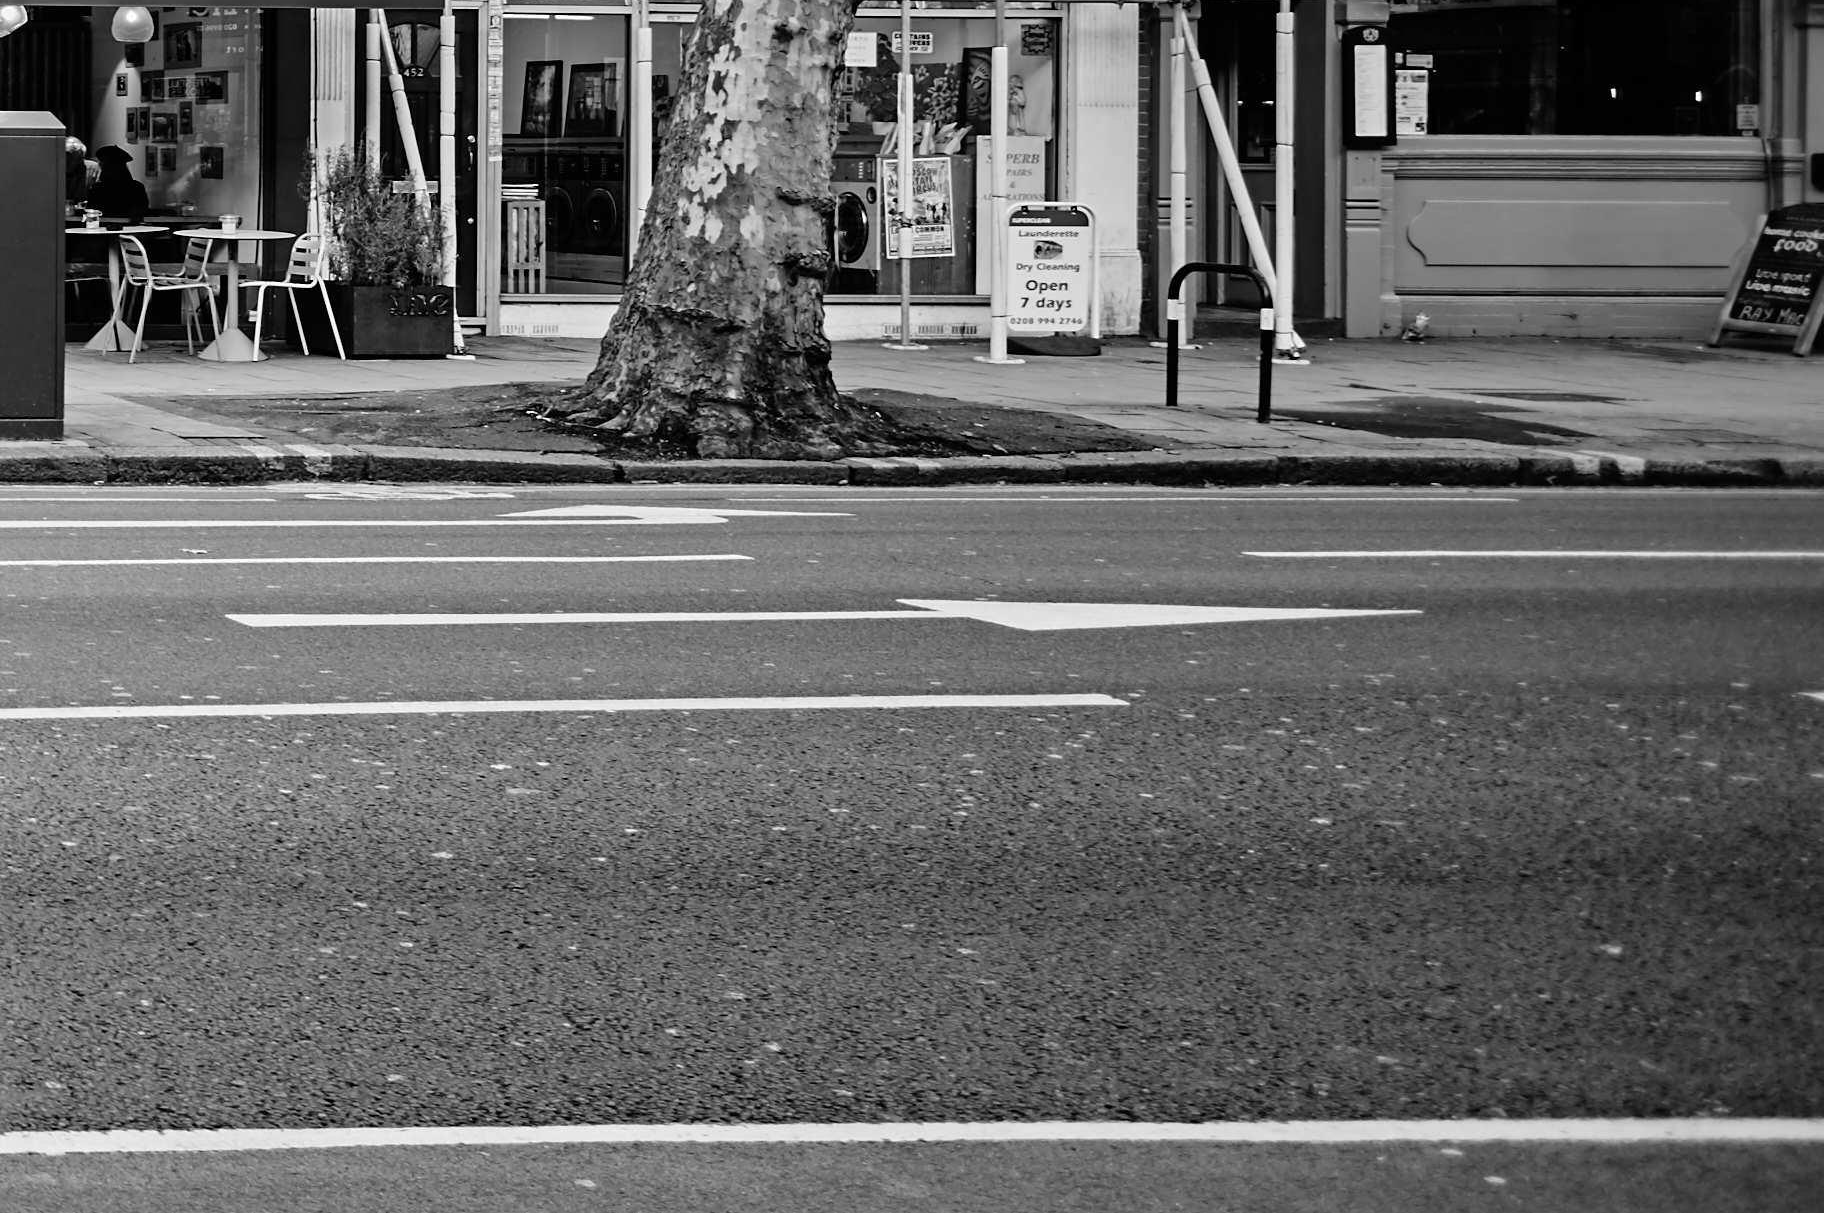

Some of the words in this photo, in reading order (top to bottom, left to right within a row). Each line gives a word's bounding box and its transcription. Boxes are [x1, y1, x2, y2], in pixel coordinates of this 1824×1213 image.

[403, 67, 425, 77] 452
[1018, 230, 1080, 238] Launderette
[1016, 263, 1033, 273] Dry
[1037, 263, 1081, 273] Cleaning
[1025, 279, 1069, 294] Open
[1020, 297, 1030, 308] 7
[1036, 297, 1073, 312] days
[1009, 317, 1034, 325] 0208
[1037, 317, 1055, 325] 994
[1059, 317, 1083, 325] 2746
